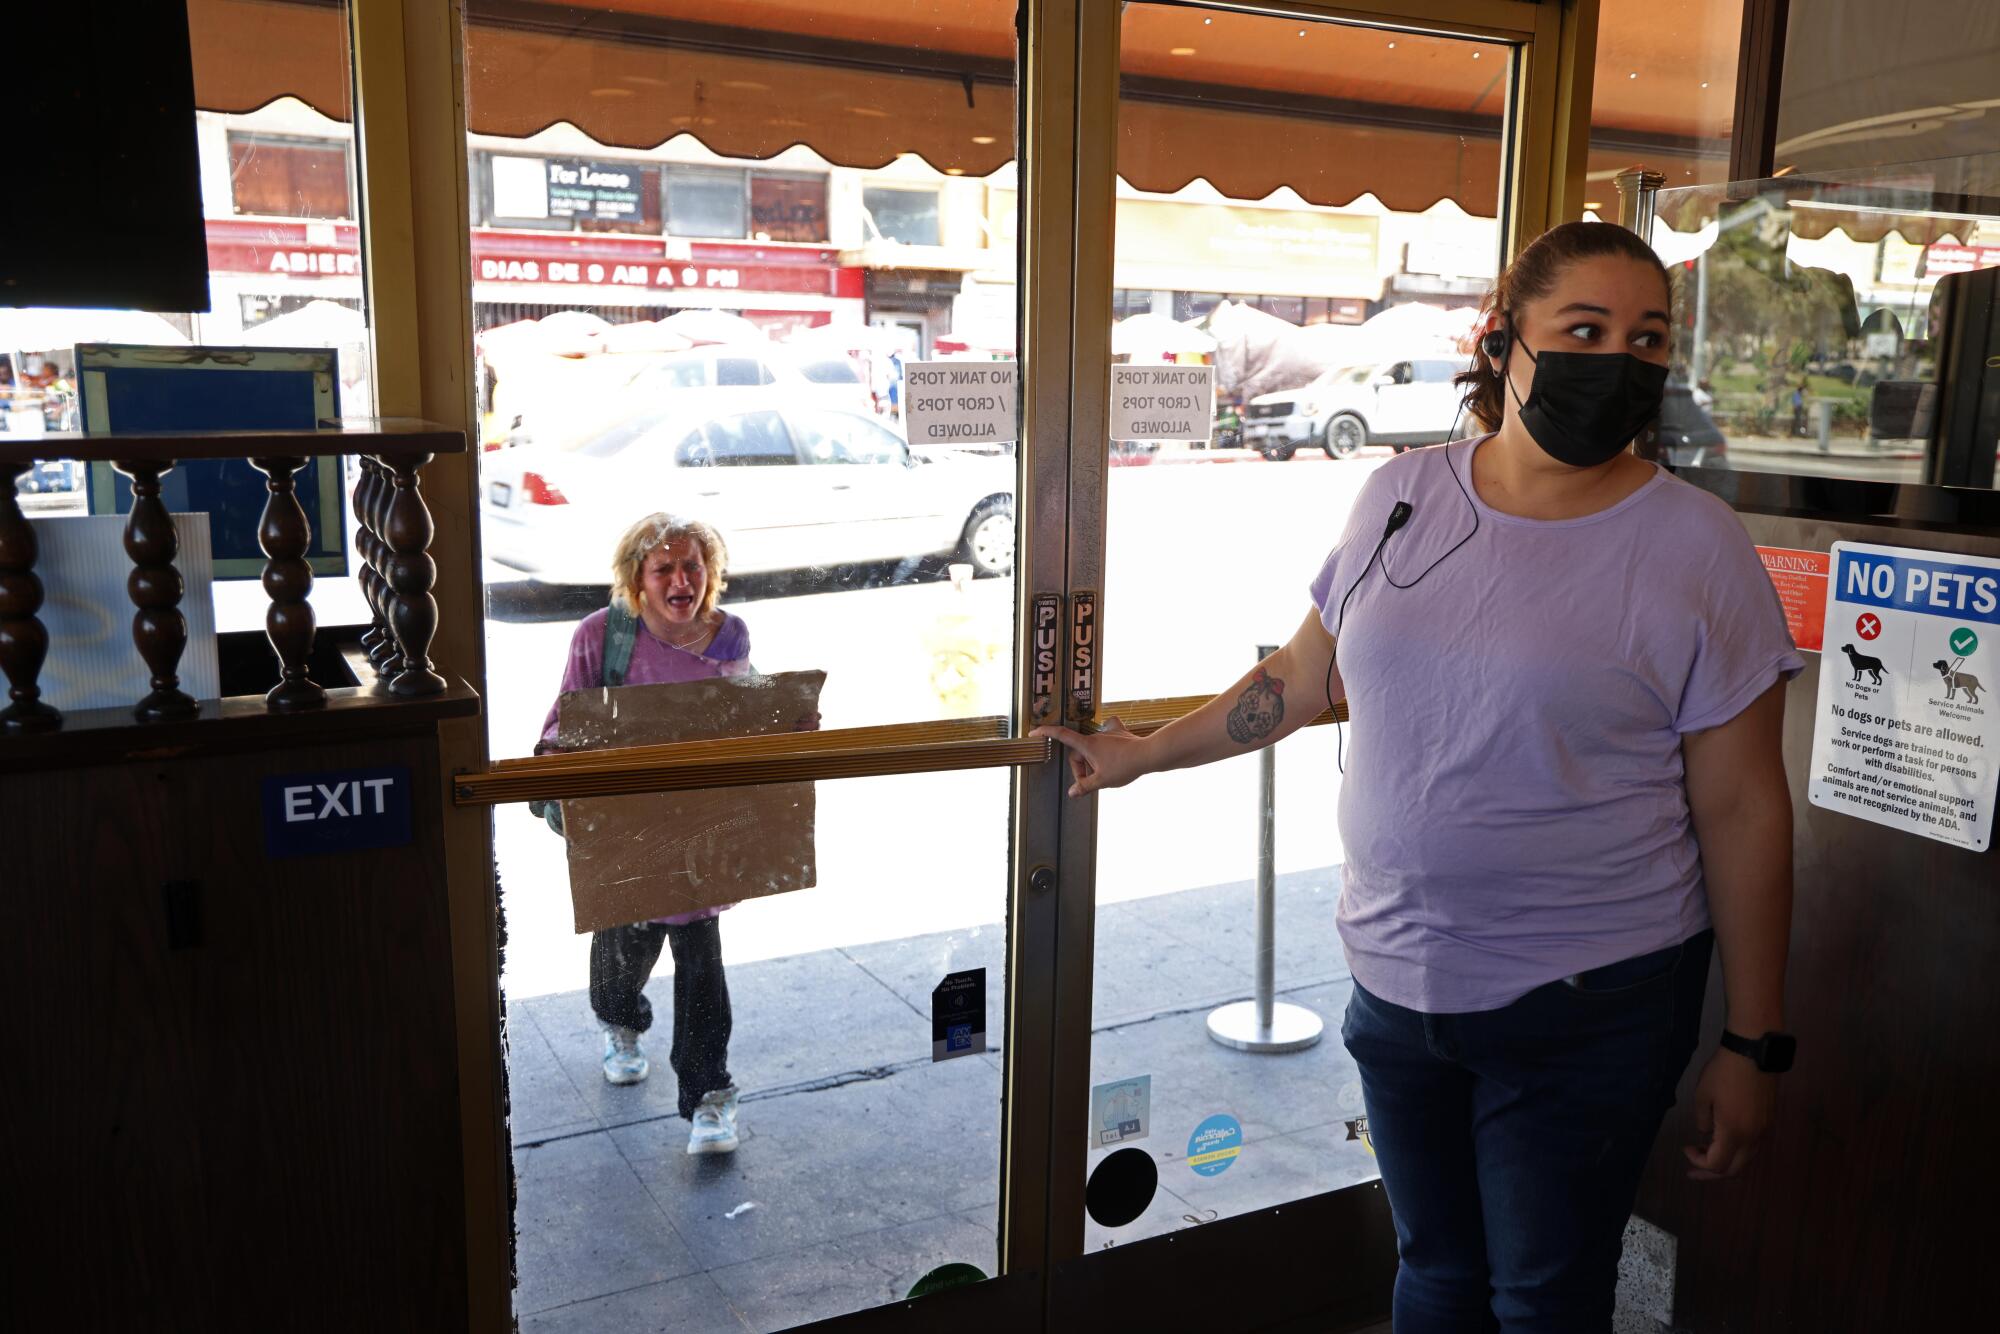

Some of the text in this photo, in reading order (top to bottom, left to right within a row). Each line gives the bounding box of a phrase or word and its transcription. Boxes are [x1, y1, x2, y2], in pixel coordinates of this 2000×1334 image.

[550, 165, 579, 184] For
[482, 260, 539, 281] DIAS
[548, 262, 580, 282] DE
[612, 265, 648, 284] AM
[656, 267, 674, 286] A
[706, 269, 739, 287] PM
[1760, 554, 1818, 572] WARNING:
[1847, 560, 1998, 614] NO PETS
[1036, 606, 1055, 694] PUSH
[1073, 603, 1093, 689] PUSH
[1845, 681, 1854, 689] No
[1855, 683, 1871, 693] Dogs
[1854, 692, 1869, 701] Pets
[1928, 698, 1985, 714] Service Animals
[1831, 704, 1984, 748] No dogs or pets are allowed.
[1939, 709, 1971, 721] Welcome
[1831, 738, 1977, 779] work or perform a task for persons
[1841, 726, 1968, 764] Service dogs are trained to do
[1827, 763, 1974, 809] Comfort and/or emotional support
[1865, 758, 1935, 782] with disabilities.
[284, 778, 394, 822] EXIT
[1822, 775, 1977, 822] animals are not service animals, and
[1833, 790, 1960, 831] are not recognized by the ADA.
